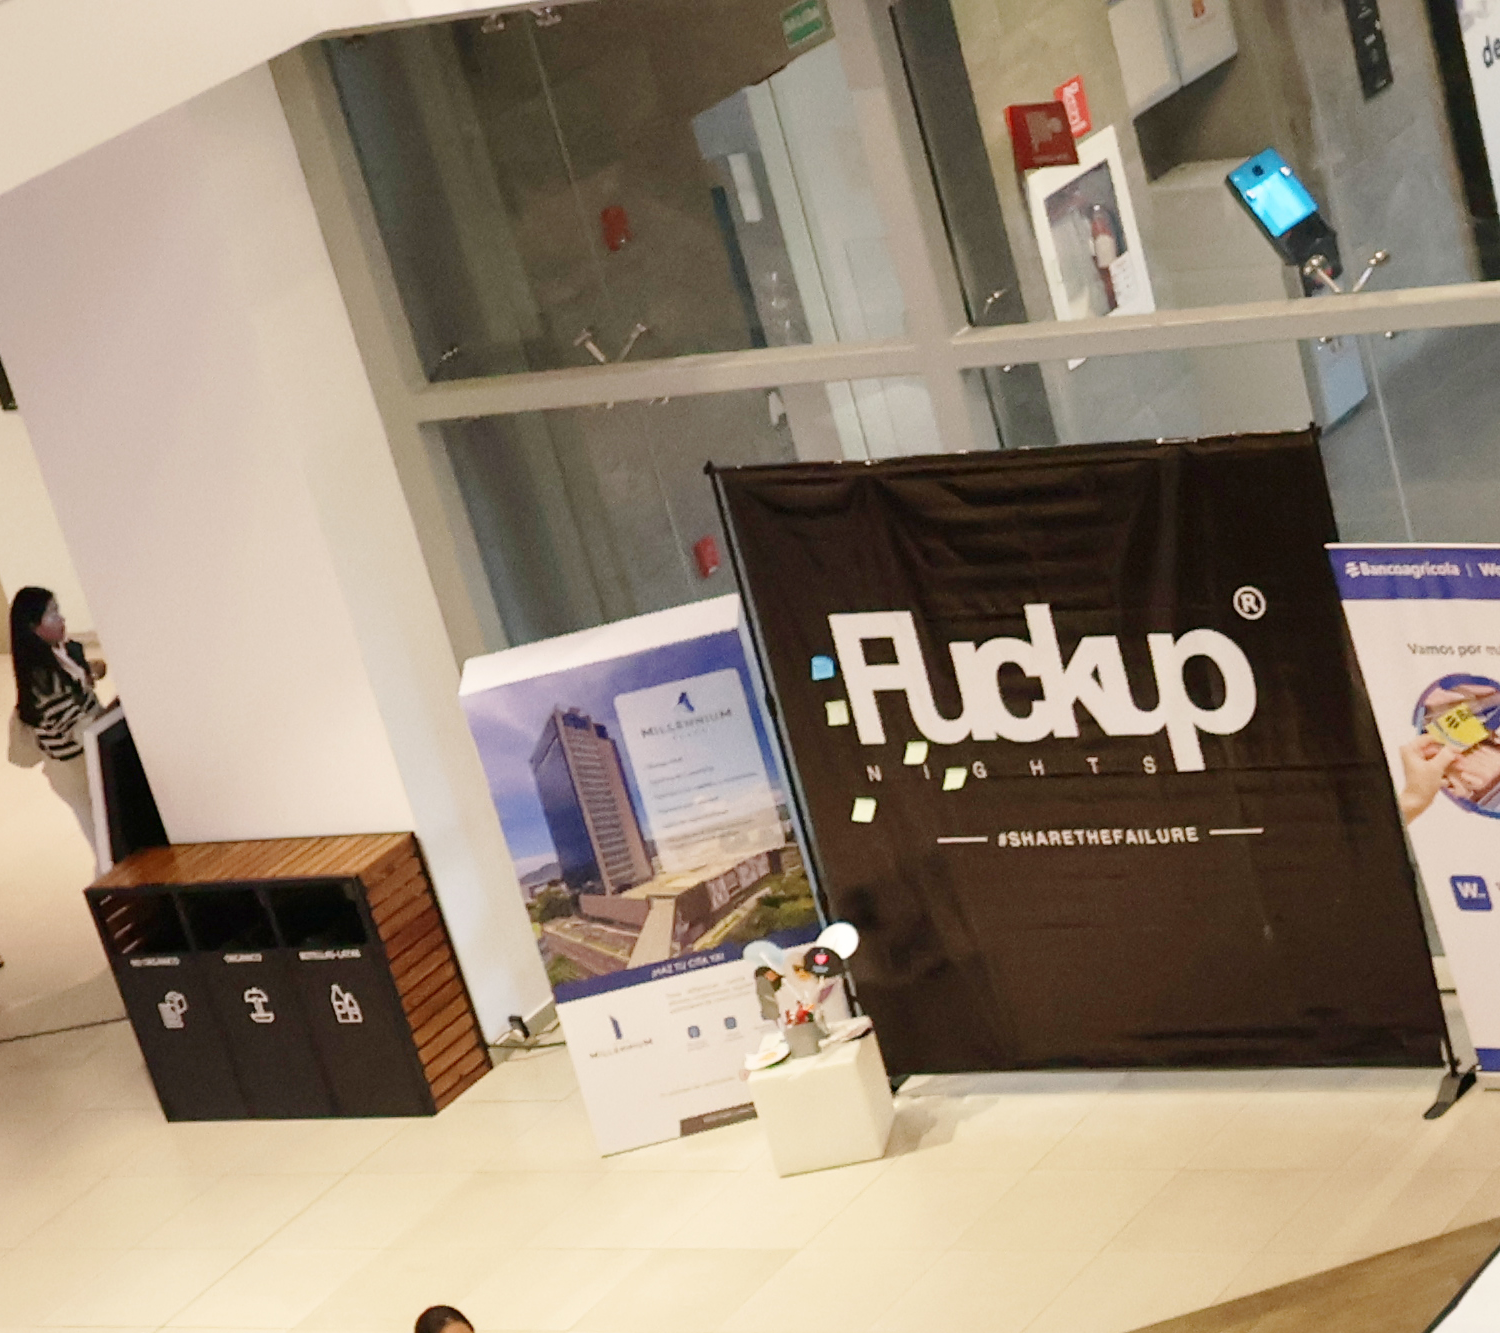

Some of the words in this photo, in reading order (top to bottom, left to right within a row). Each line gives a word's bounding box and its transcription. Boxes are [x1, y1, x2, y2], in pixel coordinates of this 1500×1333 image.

[1408, 643, 1454, 655] Vamos
[1458, 644, 1481, 657] por
[998, 827, 1199, 848] #SHARETHEFAILURE
